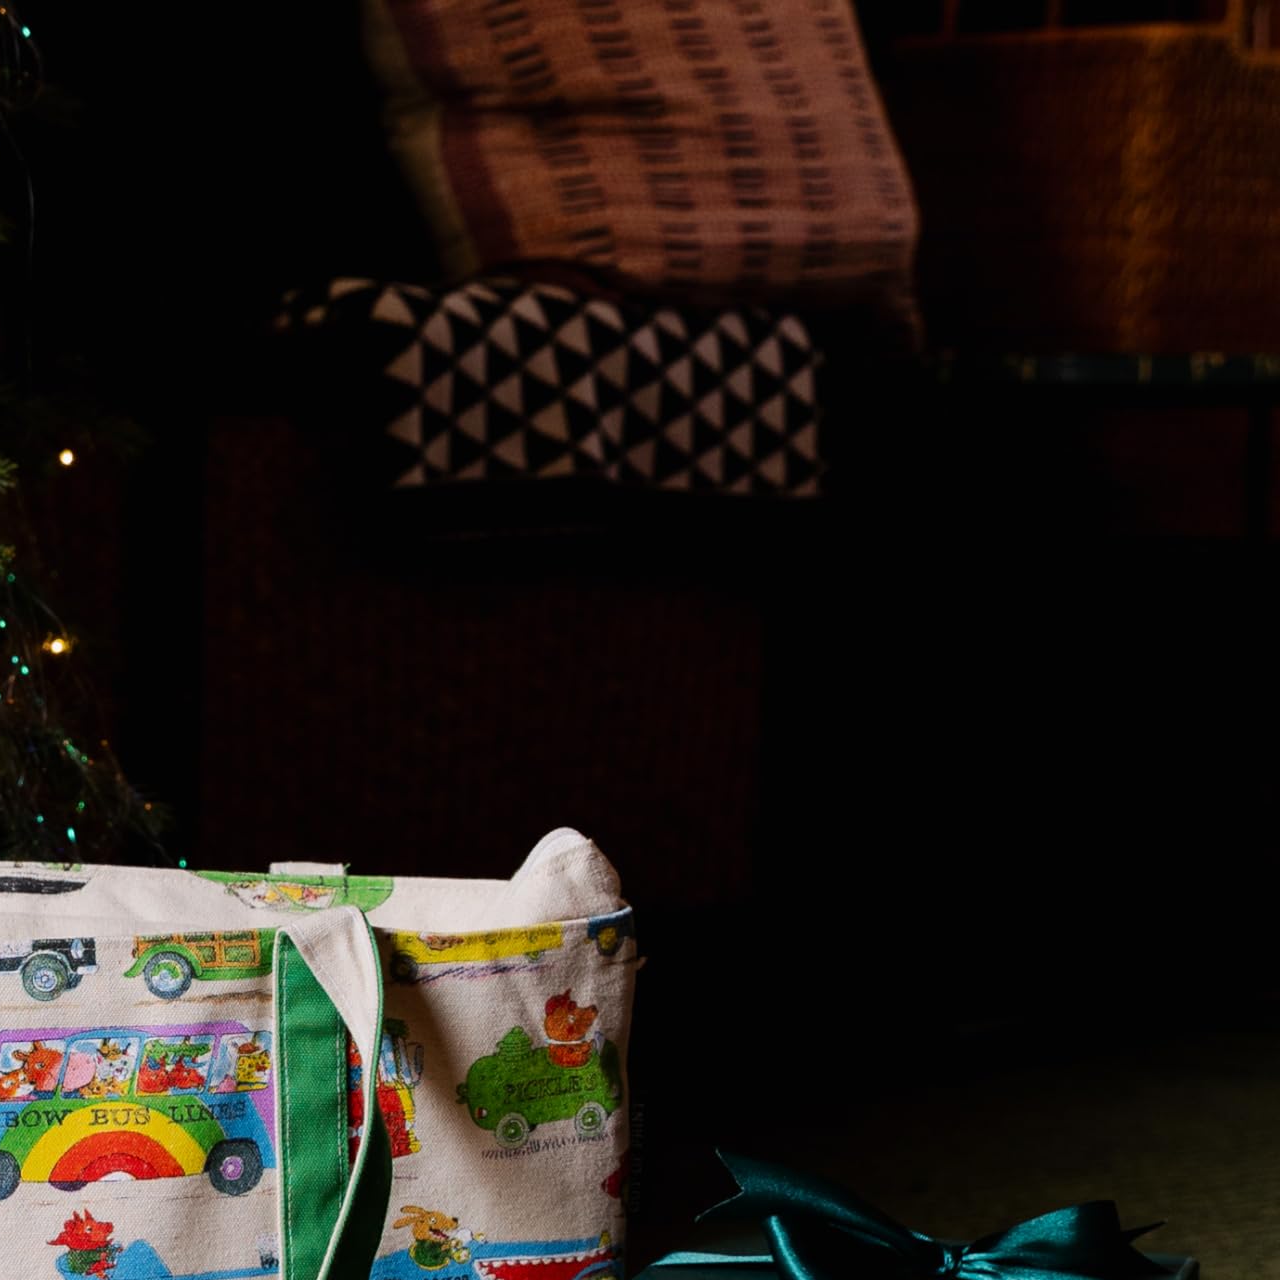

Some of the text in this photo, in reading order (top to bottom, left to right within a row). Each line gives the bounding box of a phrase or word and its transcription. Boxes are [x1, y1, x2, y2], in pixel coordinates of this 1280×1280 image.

[504, 1074, 596, 1104] PICKLES
[88, 1106, 151, 1127] BUS
[167, 1101, 247, 1125] LINES
